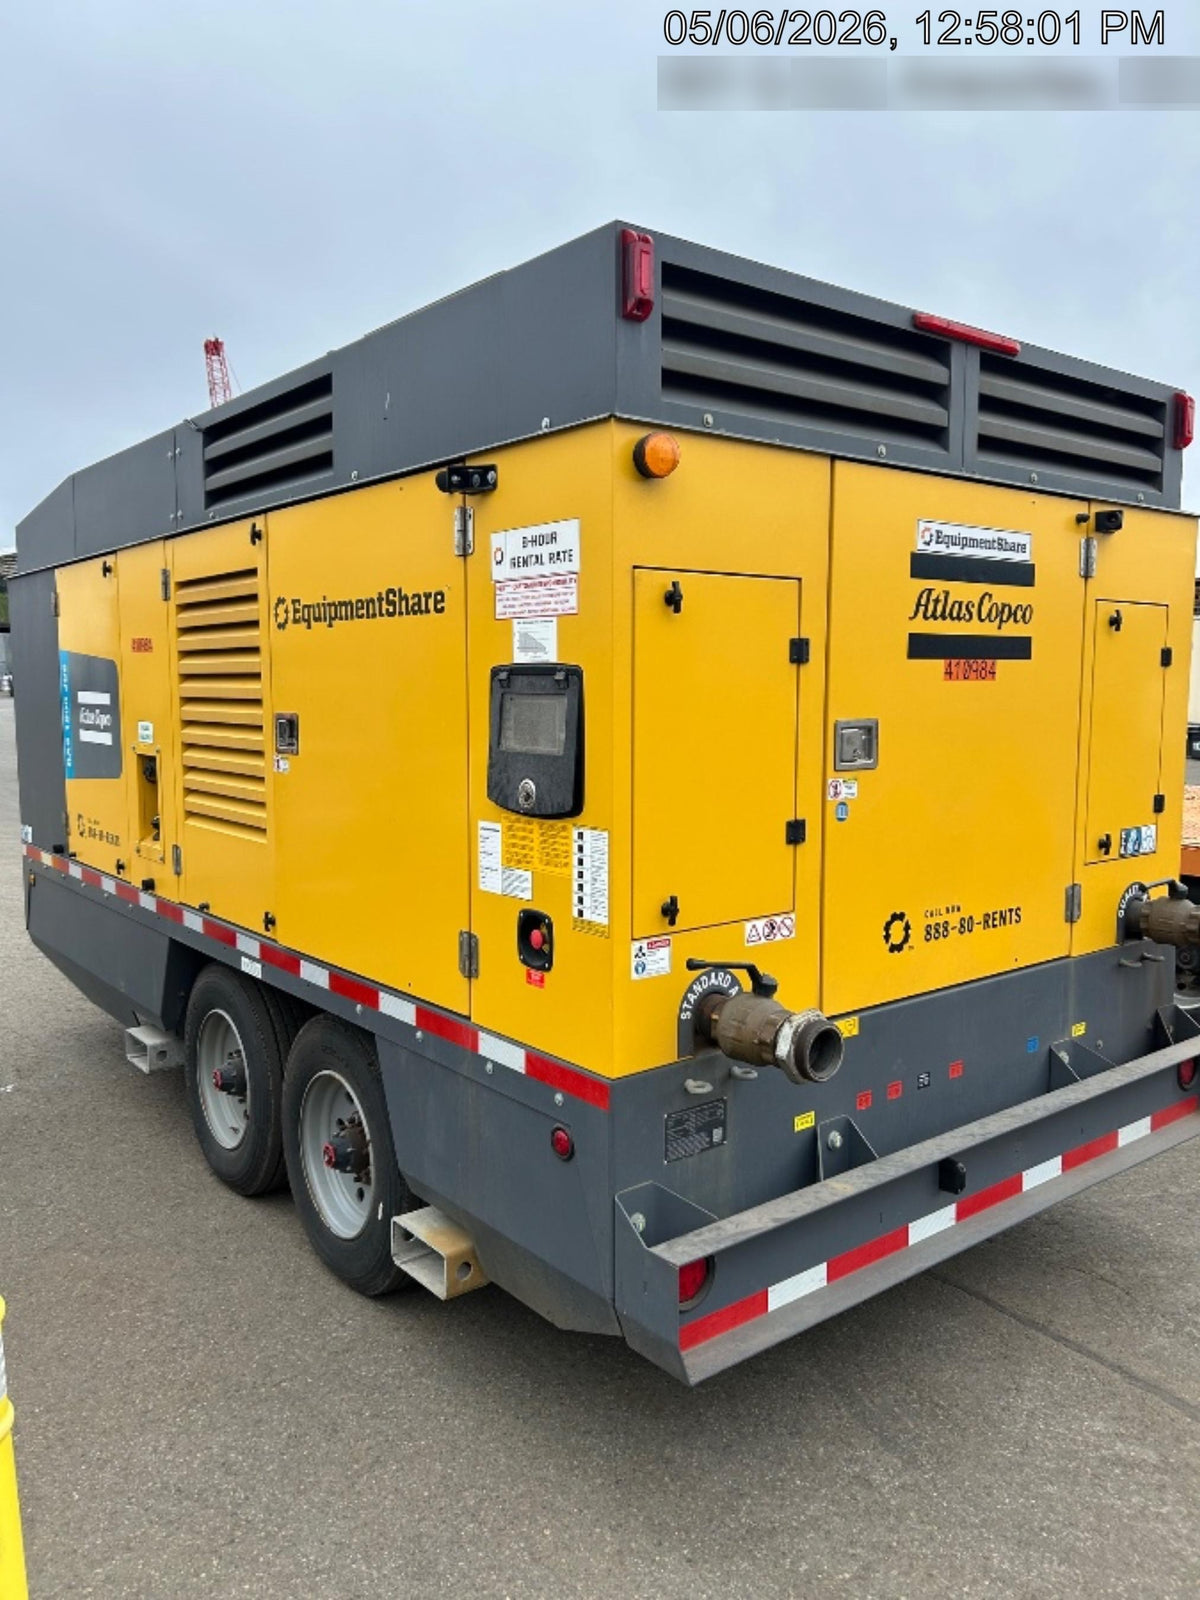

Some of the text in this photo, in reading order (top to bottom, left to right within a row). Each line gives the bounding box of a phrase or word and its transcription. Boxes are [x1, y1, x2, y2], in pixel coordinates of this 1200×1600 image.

[510, 548, 574, 569] RENTAL RATE
[935, 529, 1027, 553] EquipmentShare
[291, 587, 446, 629] EquipmentShare
[908, 588, 1033, 630] Atlas Copco
[924, 906, 1021, 942] 888-80-RENTS
[680, 972, 732, 1019] STANDARD
